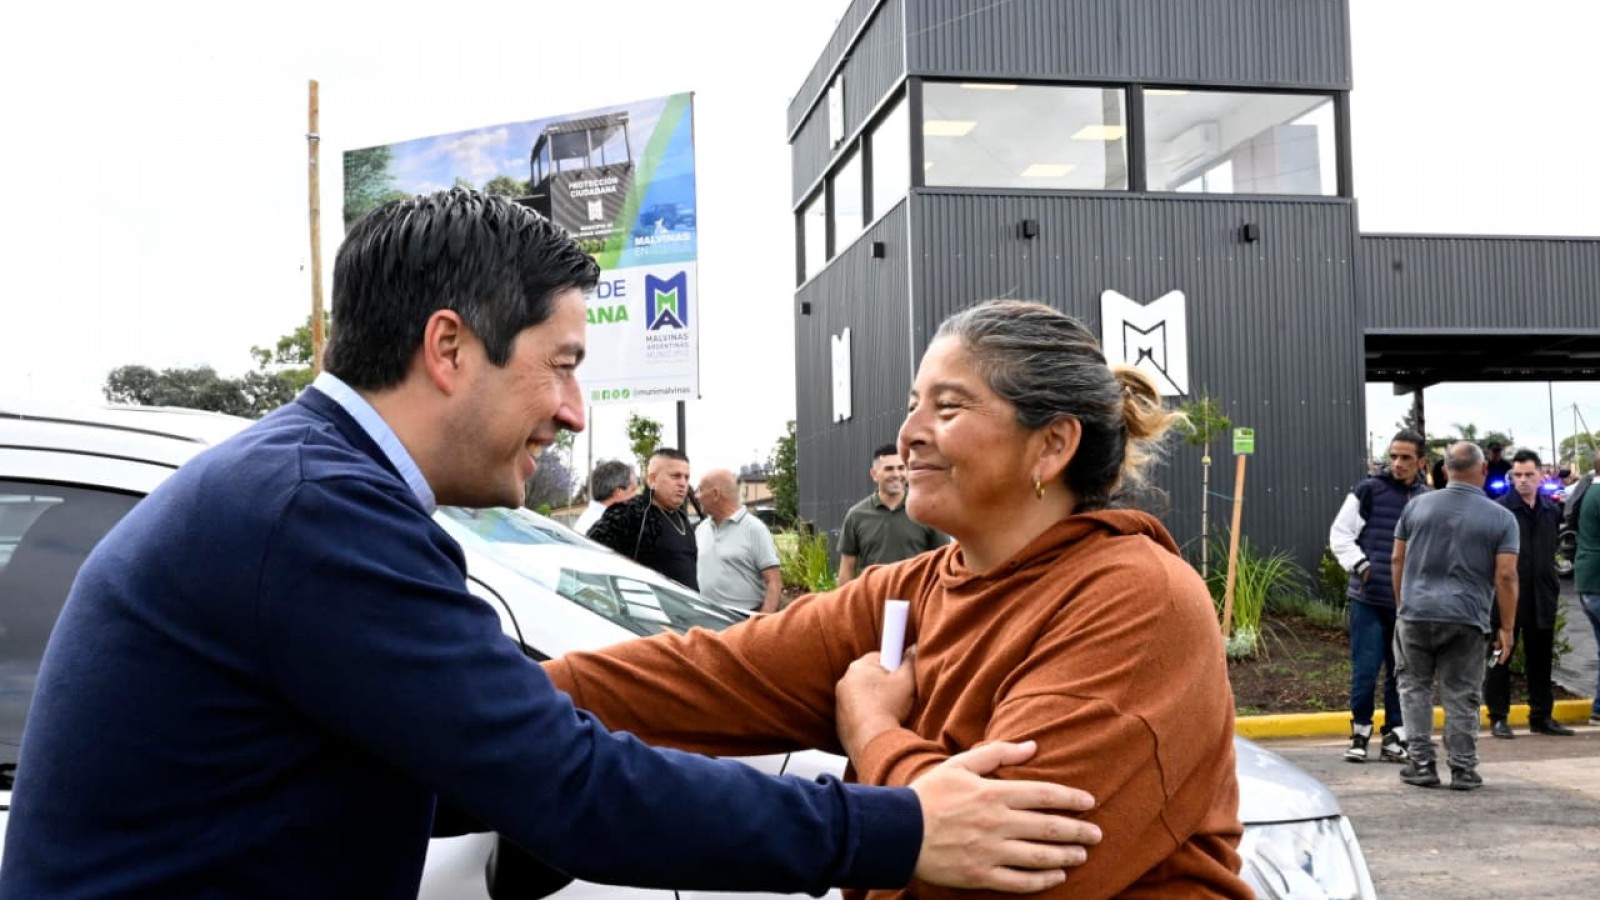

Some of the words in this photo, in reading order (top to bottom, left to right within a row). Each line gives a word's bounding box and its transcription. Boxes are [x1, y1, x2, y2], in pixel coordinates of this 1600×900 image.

[570, 185, 617, 198] CIUDADANA
[634, 232, 691, 246] MALVINAS
[597, 279, 626, 299] DE
[586, 304, 630, 325] ANA
[645, 332, 689, 342] MALVINAS
